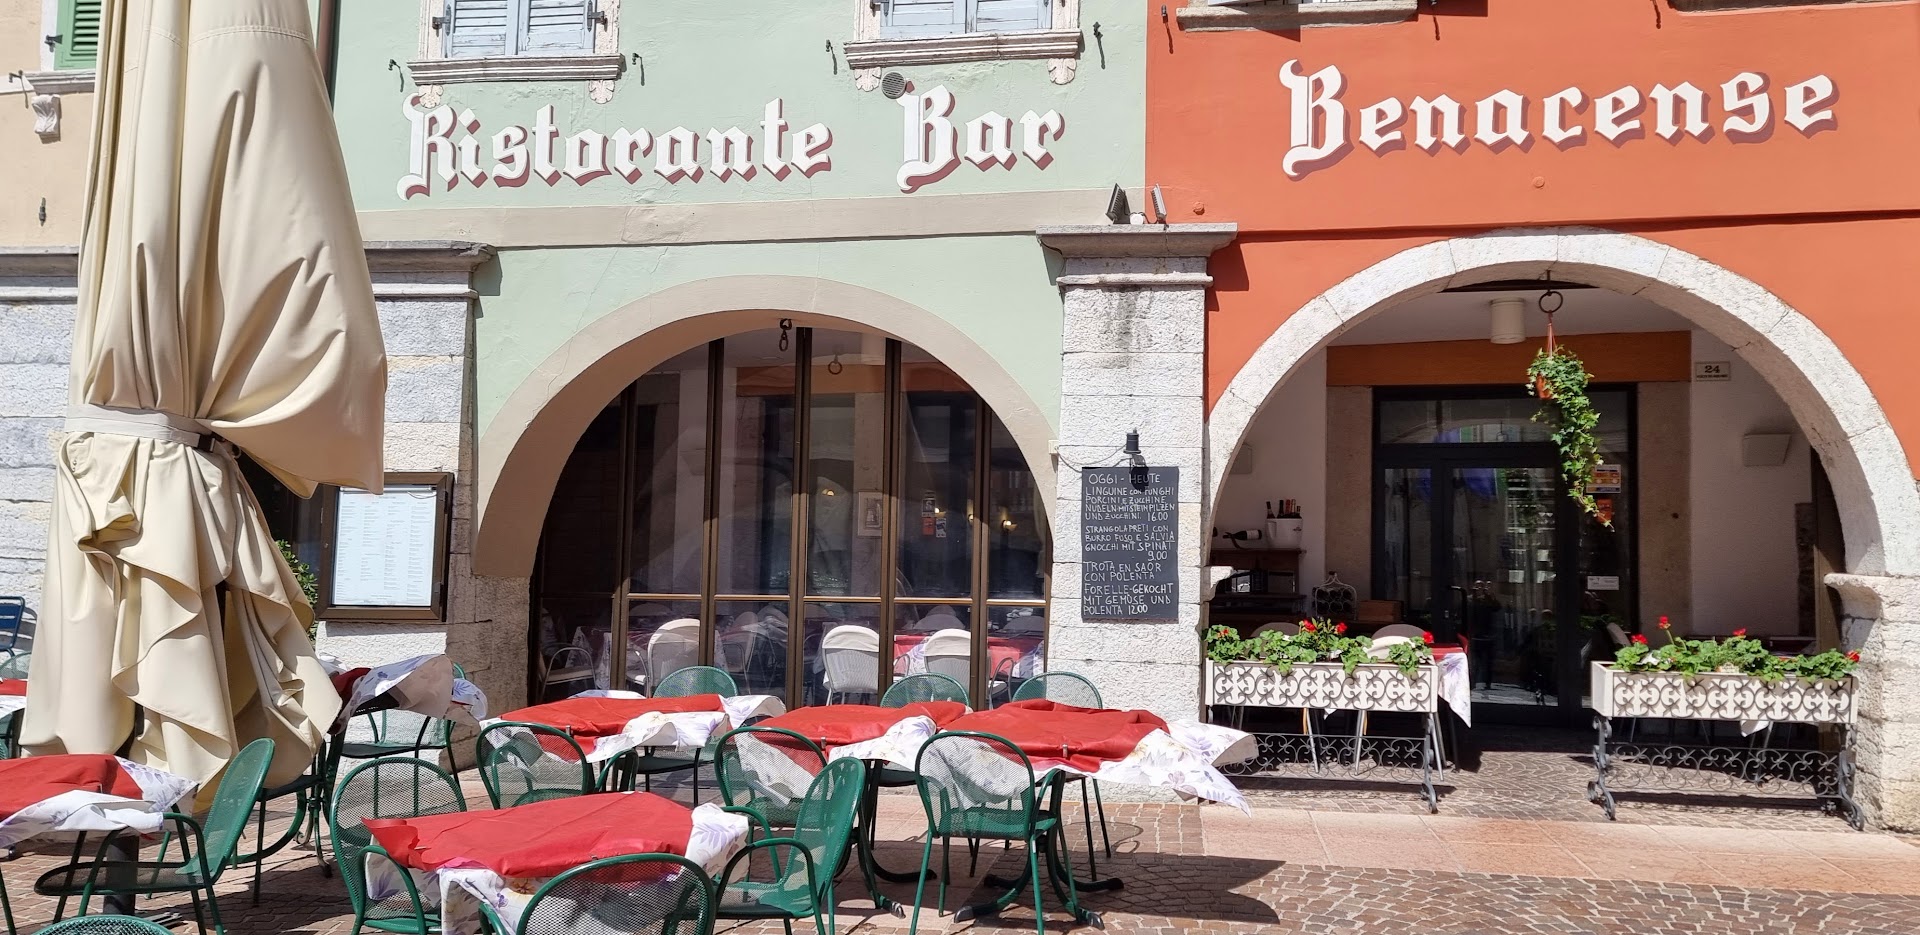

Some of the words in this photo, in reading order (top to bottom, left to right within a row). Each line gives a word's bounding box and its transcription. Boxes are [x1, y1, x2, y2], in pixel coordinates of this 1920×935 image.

[1279, 59, 1840, 182] Benacense
[397, 93, 833, 200] Ristorante
[896, 80, 1066, 194] Bar
[1704, 365, 1720, 374] 24
[1089, 474, 1118, 484] OGGI
[1129, 473, 1160, 483] HEUTE
[1085, 487, 1127, 495] LINGUINE
[1144, 487, 1174, 495] FUNGHI
[1085, 496, 1120, 504] PORCINI
[1115, 534, 1132, 542] FUSO
[1144, 531, 1175, 542] SALVIA
[1085, 543, 1119, 551] GNOCCHI
[1122, 541, 1135, 550] MIT
[1137, 541, 1171, 551] SPINAT
[1148, 551, 1167, 561] 9.00
[1083, 561, 1115, 572] TROTA
[1119, 563, 1130, 572] EN
[1135, 563, 1161, 572] SAOR
[1084, 573, 1105, 581] CON
[1110, 572, 1155, 581] POLENTA
[1084, 596, 1102, 605] MIT
[1151, 595, 1171, 604] UND
[1083, 605, 1123, 615] POLENTA
